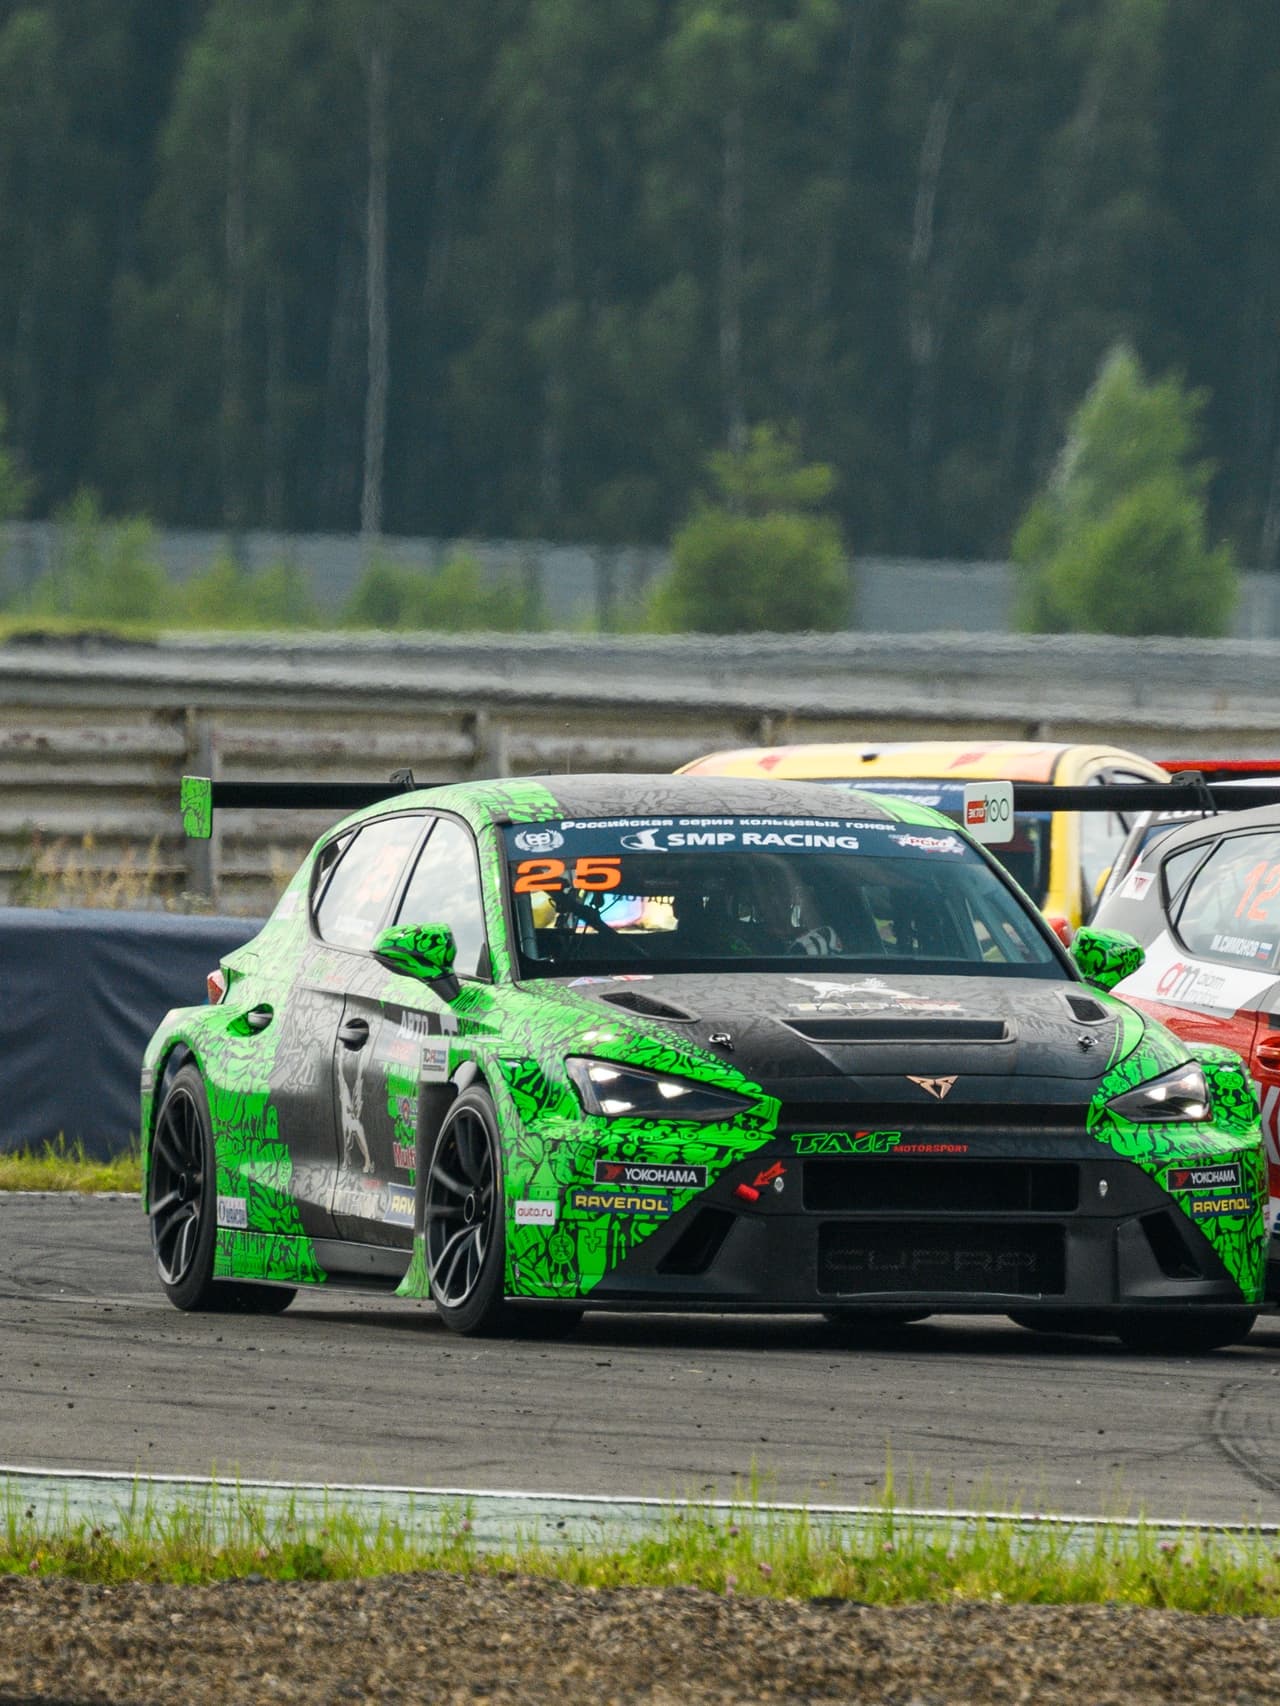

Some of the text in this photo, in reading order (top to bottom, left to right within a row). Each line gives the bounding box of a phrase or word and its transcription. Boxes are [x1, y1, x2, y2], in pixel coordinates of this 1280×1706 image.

[560, 818, 897, 832] Российская серия кольцевых гонок
[667, 832, 860, 850] SMP RACING
[513, 857, 622, 893] 25
[893, 1144, 969, 1153] MOTORSPORT
[624, 1167, 698, 1183] YOKOHAMA
[1190, 1169, 1237, 1184] YOKOHAMA
[575, 1194, 669, 1212] RAVENOL
[1193, 1198, 1250, 1213] RAVENOL
[517, 1206, 553, 1217] auto.ru
